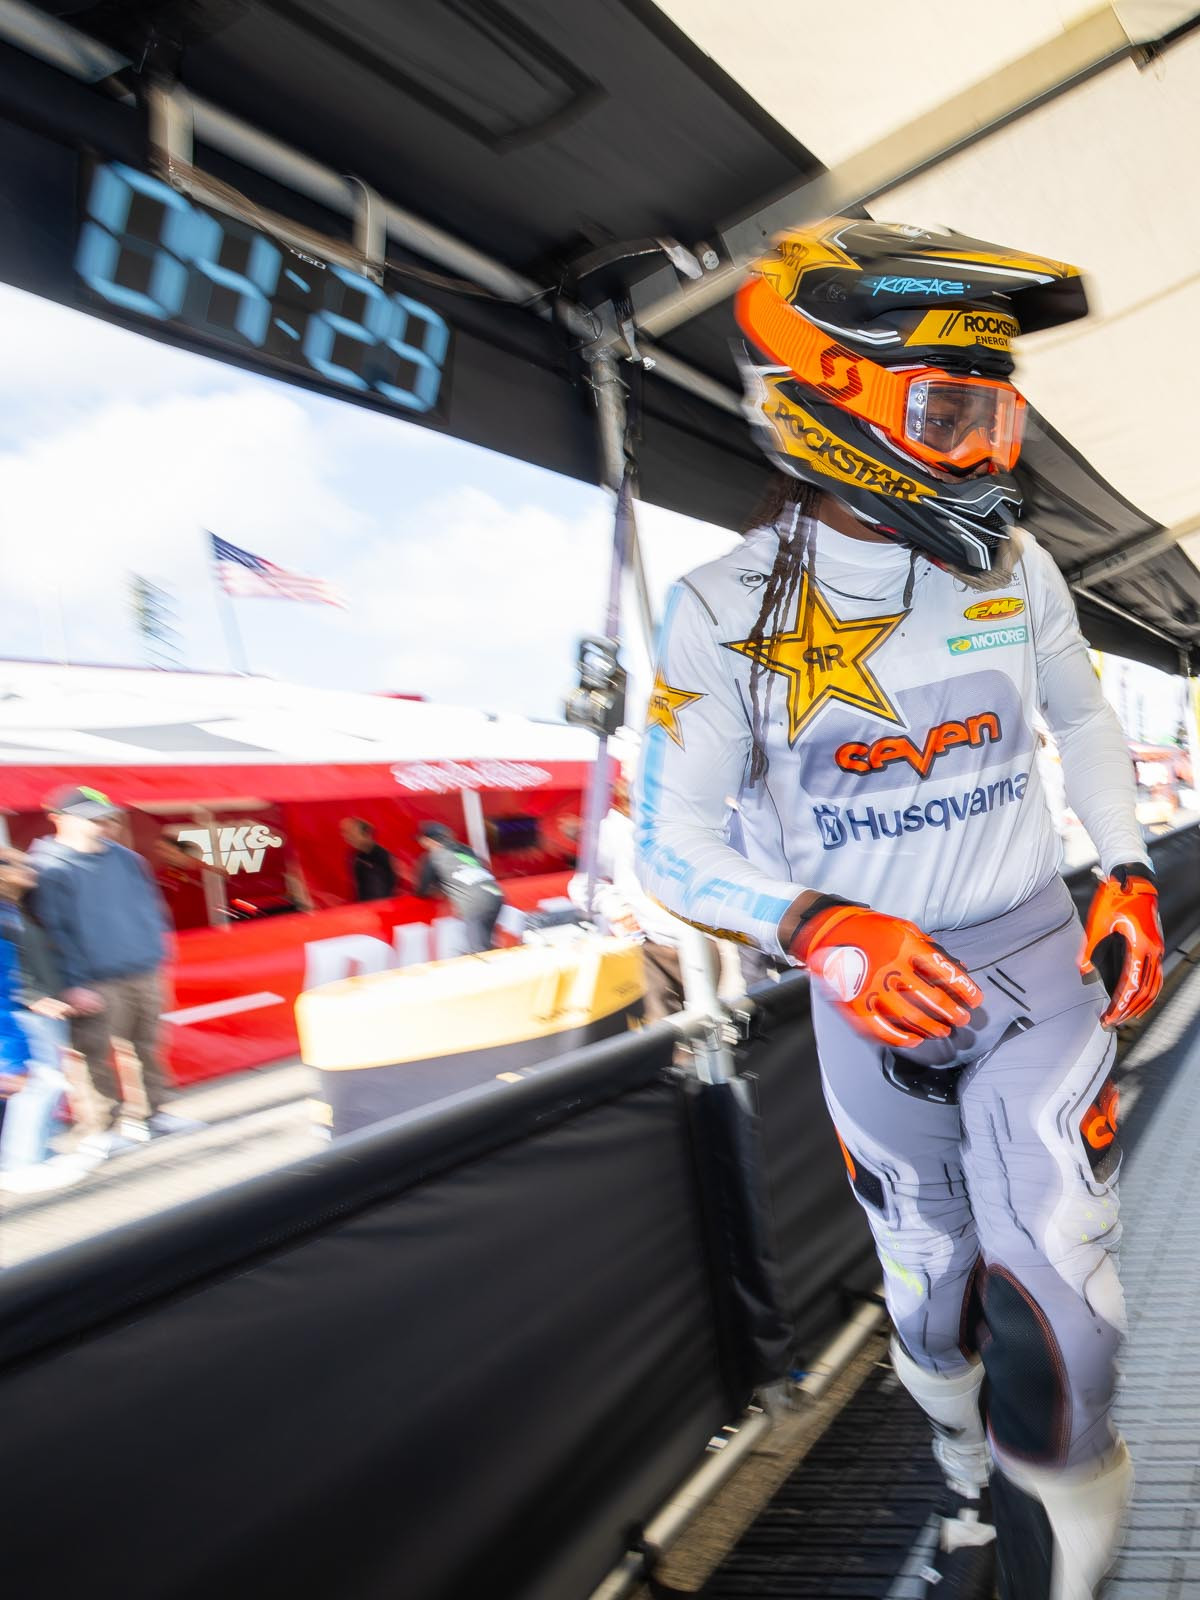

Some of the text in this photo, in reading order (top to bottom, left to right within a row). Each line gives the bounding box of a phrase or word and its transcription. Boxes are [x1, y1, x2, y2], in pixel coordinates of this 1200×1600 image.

[290, 249, 326, 270] 450
[75, 161, 450, 413] 04:29
[964, 315, 1020, 338] ROCKST
[975, 335, 1008, 346] ENERGY
[775, 400, 917, 500] ROCKSTAR
[966, 597, 1025, 620] FMF
[971, 629, 1026, 649] MOTORE
[846, 773, 1029, 842] Husqvarna
